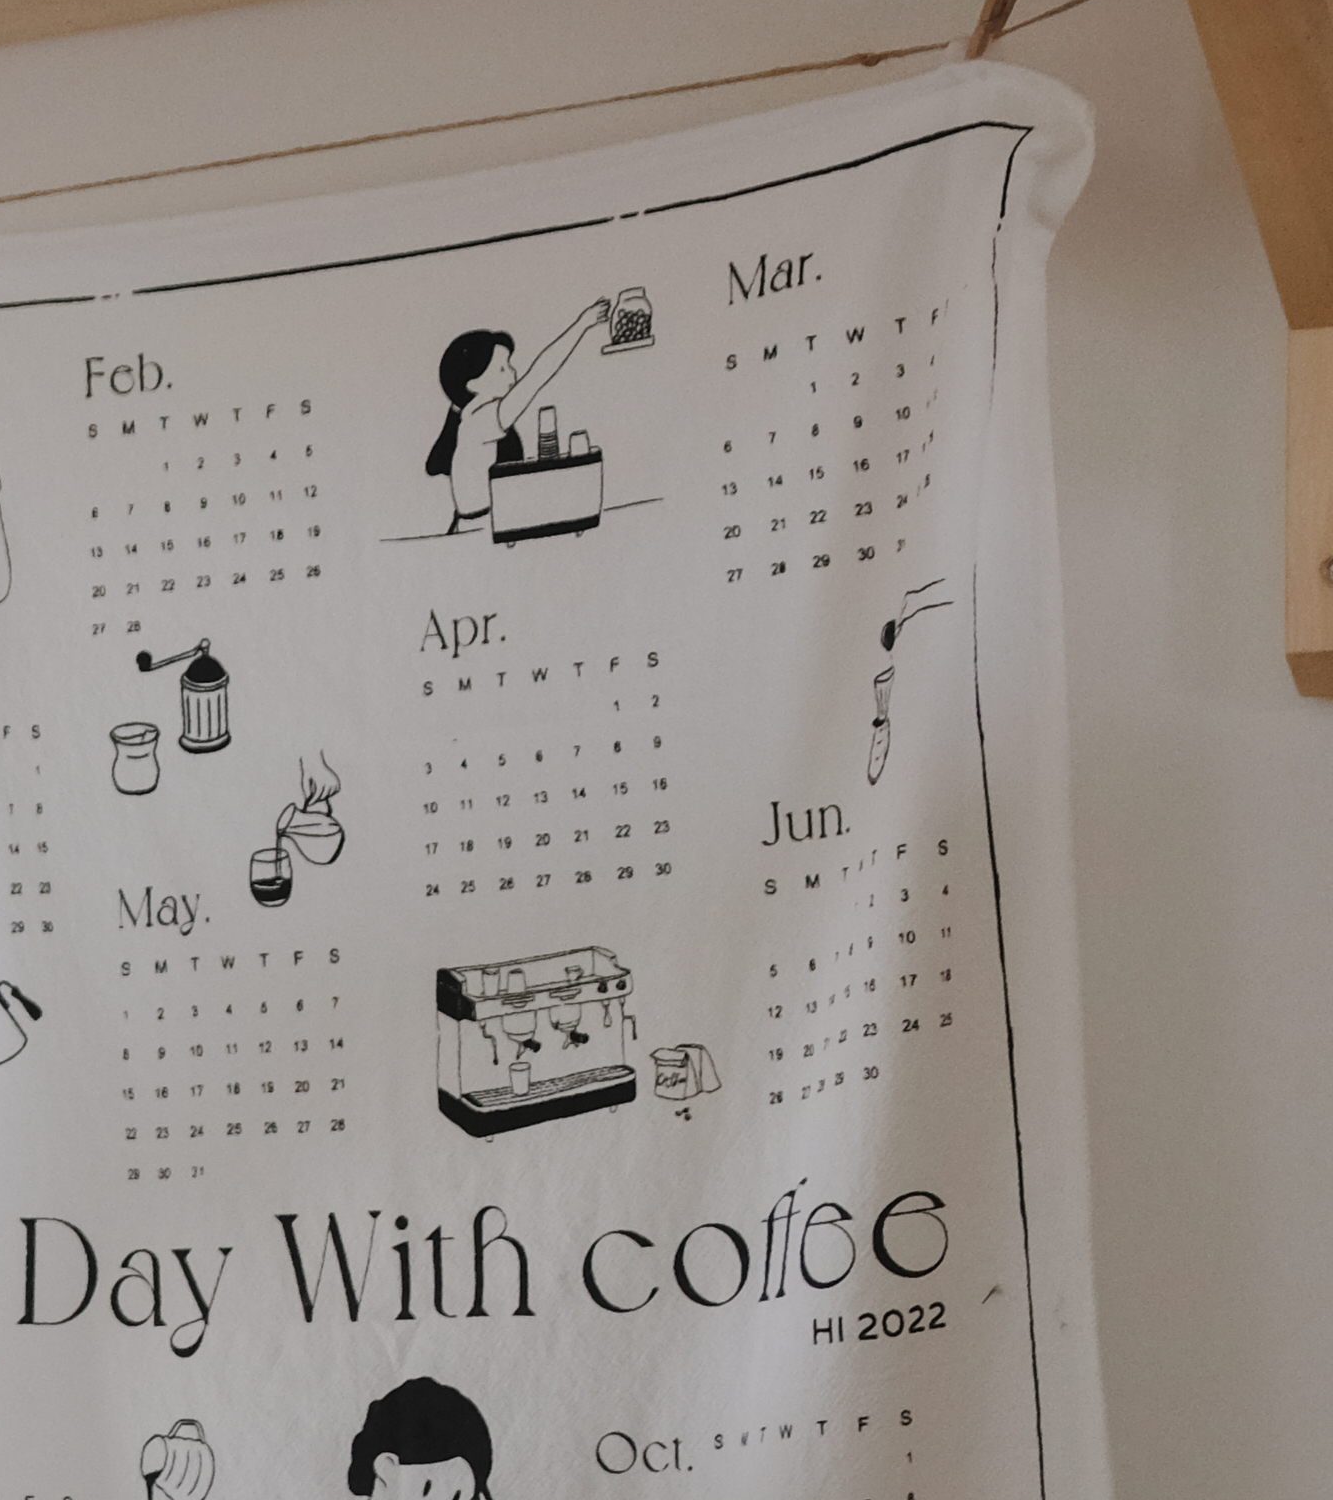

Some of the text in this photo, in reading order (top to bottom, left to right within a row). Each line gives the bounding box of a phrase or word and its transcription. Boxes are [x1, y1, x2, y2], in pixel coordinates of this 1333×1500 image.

[729, 252, 821, 305] Mar.
[85, 353, 172, 399] Feb.
[88, 399, 311, 440] S M T W T F S
[723, 501, 873, 540] 20 21 22 23
[92, 565, 321, 599] 20 21 22 23 24 25 26
[420, 609, 506, 659] Apr.
[423, 652, 659, 697] S M T W T F S
[3, 725, 10, 739] F
[31, 724, 41, 739] S
[425, 820, 670, 855] 17 18 19 20 21 22 23
[761, 801, 850, 846] Jun.
[119, 886, 210, 936] May.
[17, 1216, 234, 1358] Day
[274, 1205, 537, 1324] With
[581, 1176, 949, 1314] coffee
[811, 1302, 948, 1346] HI 2022
[595, 1431, 693, 1474] Oct.
